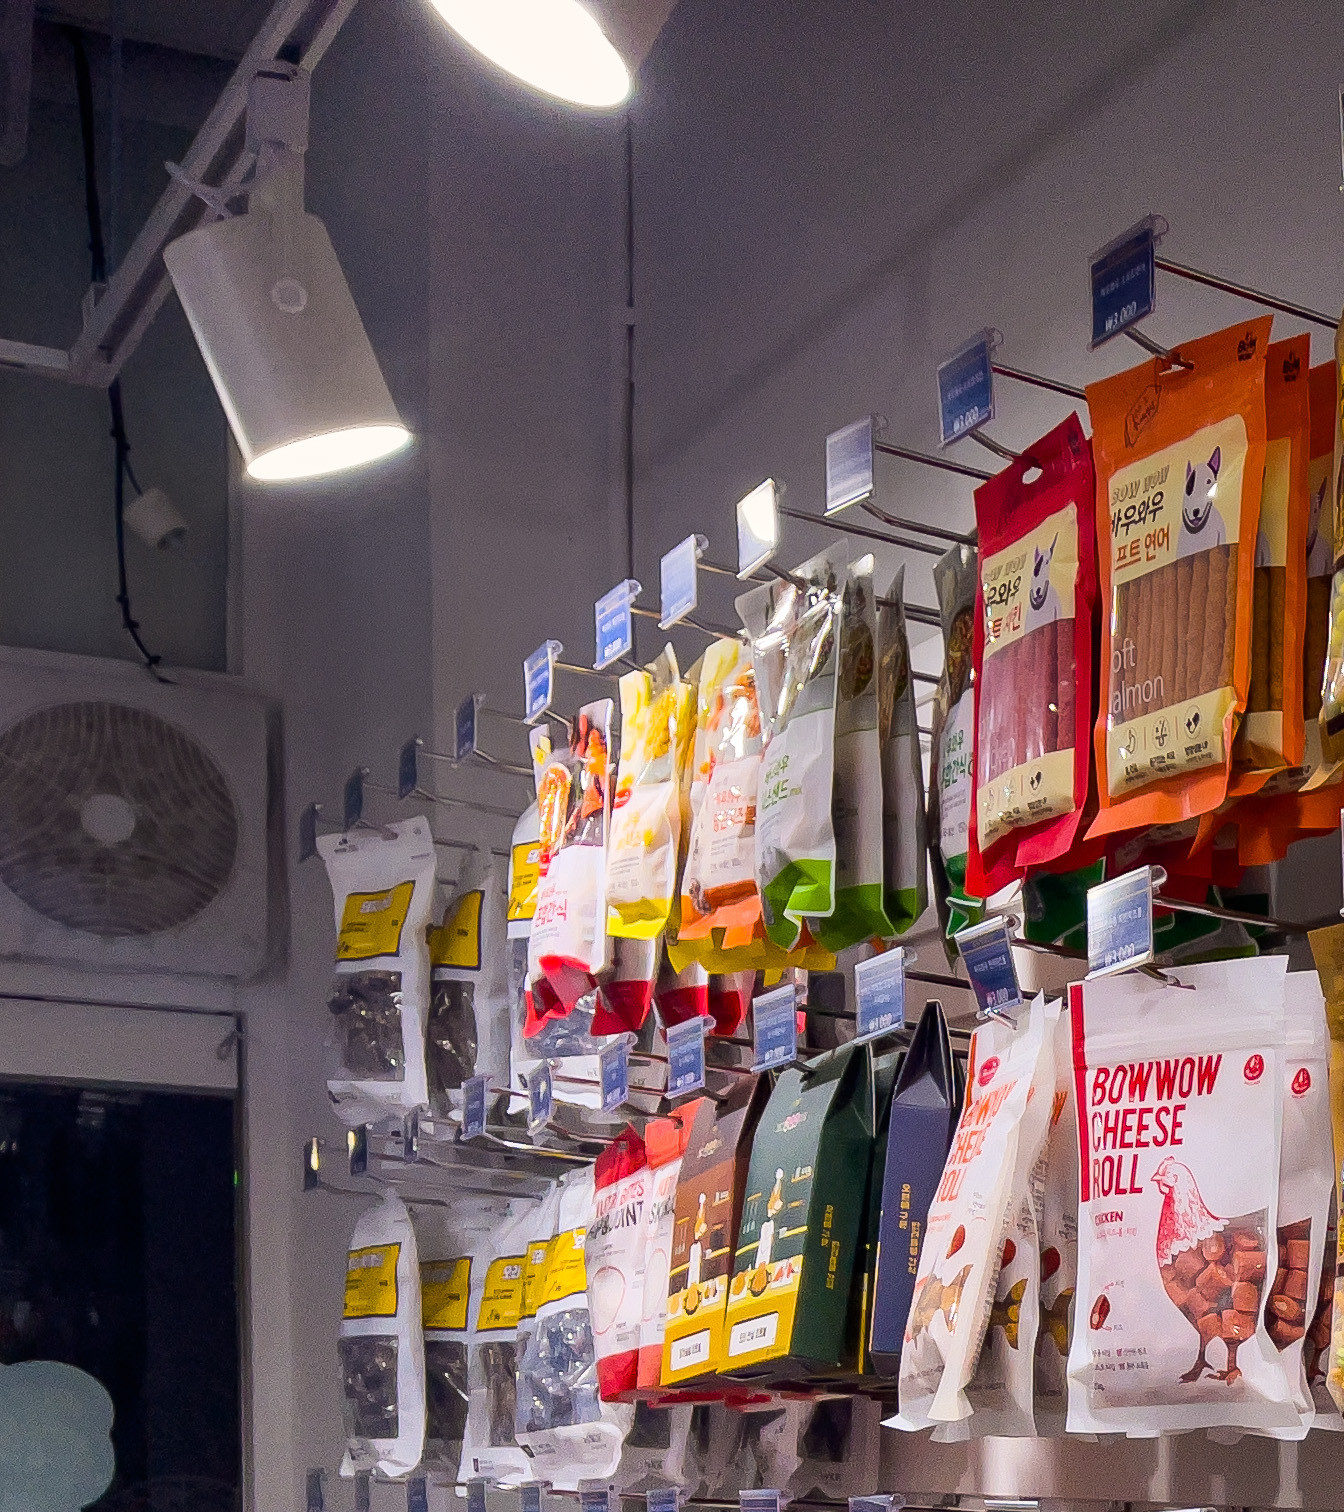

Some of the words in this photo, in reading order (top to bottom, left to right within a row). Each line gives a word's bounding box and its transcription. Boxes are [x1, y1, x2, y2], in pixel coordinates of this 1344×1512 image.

[1116, 535, 1140, 570] 프트
[1112, 643, 1135, 673] oft
[1112, 674, 1164, 714] almon
[1092, 1054, 1222, 1105] BOWWOW
[1092, 1103, 1186, 1152] CHEESE
[1092, 1153, 1143, 1199] ROLL
